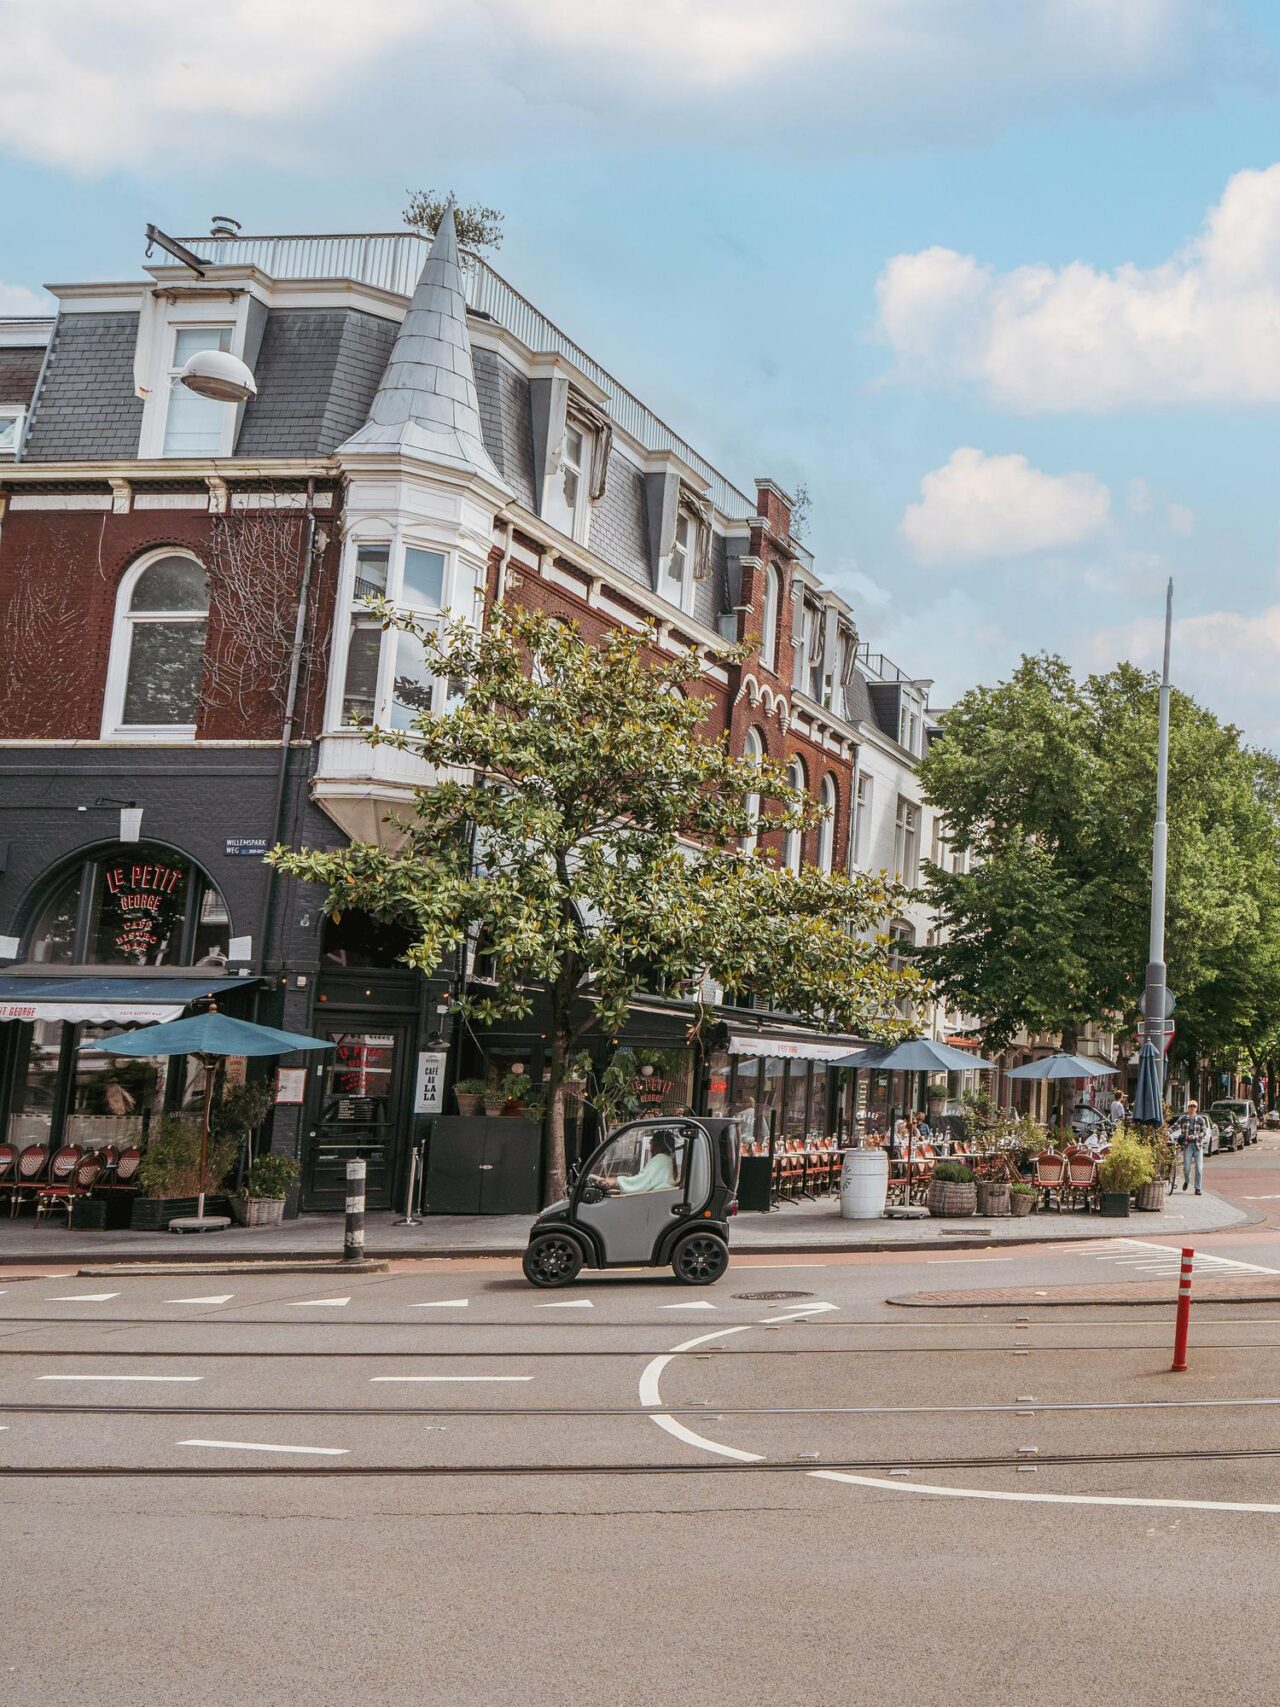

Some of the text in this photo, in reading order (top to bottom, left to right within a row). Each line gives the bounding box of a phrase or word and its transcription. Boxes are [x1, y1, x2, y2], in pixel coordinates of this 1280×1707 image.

[226, 839, 266, 847] WILLEMSPARK
[106, 865, 183, 893] LE PETIT
[120, 893, 162, 911] GEORGE
[9, 1007, 37, 1017] GEORGE
[424, 1066, 439, 1076] CAFÉ
[427, 1076, 436, 1084] AU
[423, 1084, 437, 1093] LA
[423, 1093, 436, 1101] LA
